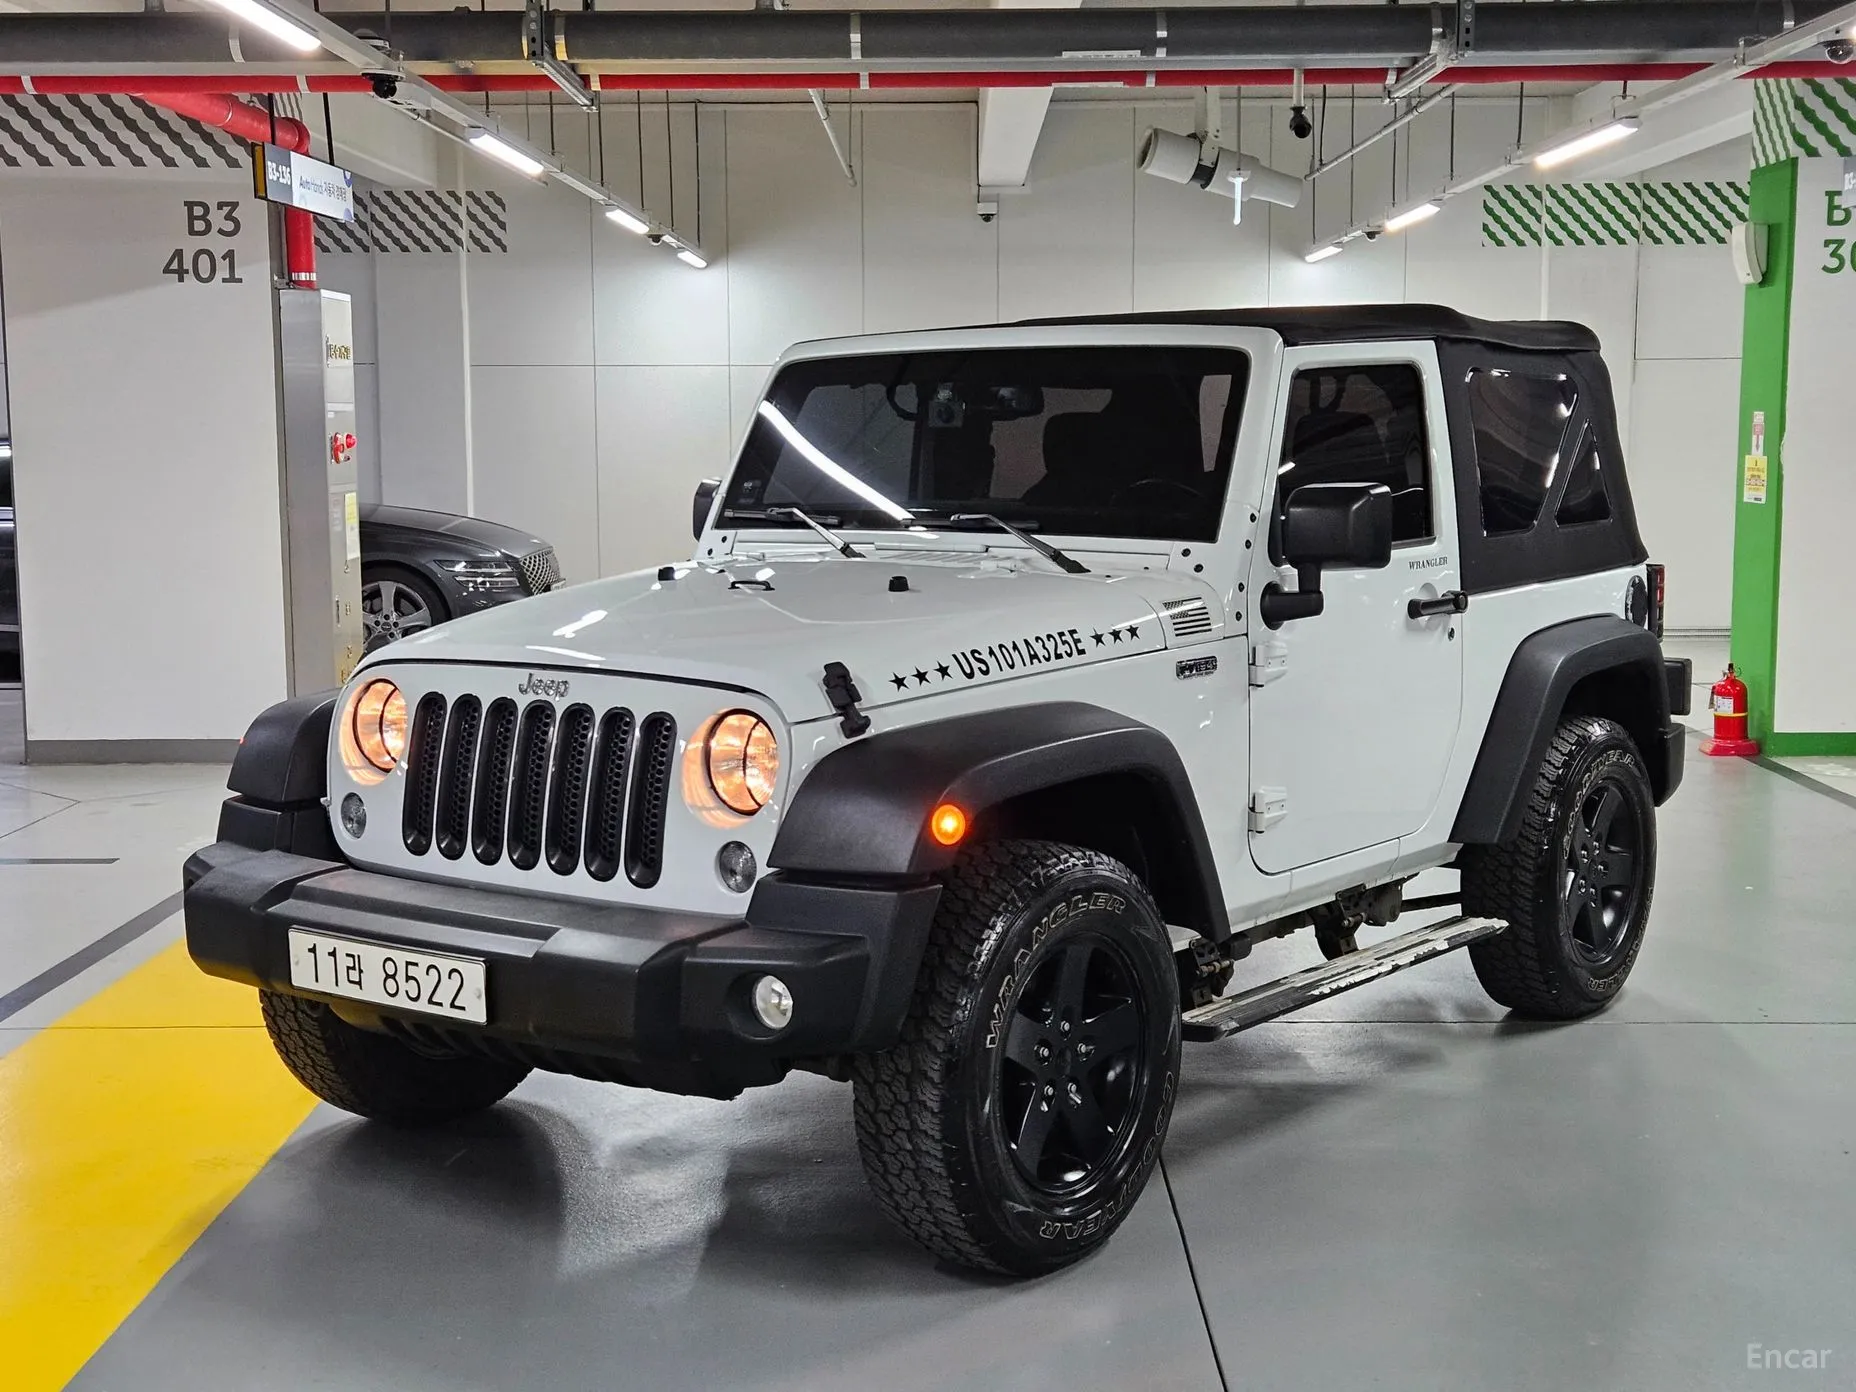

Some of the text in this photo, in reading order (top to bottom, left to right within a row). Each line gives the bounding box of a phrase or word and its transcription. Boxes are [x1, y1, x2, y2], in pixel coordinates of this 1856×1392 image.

[267, 161, 291, 185] B3-136
[184, 201, 241, 237] B3
[162, 248, 243, 284] 401
[1821, 239, 1856, 274] 3
[1408, 556, 1448, 570] WRANGLER
[952, 628, 1087, 680] US101A325E
[518, 672, 570, 702] Jeep
[307, 943, 467, 1012] 11라 8522
[985, 892, 1127, 1048] WRANGLER
[1039, 1071, 1175, 1240] GOODYEAR
